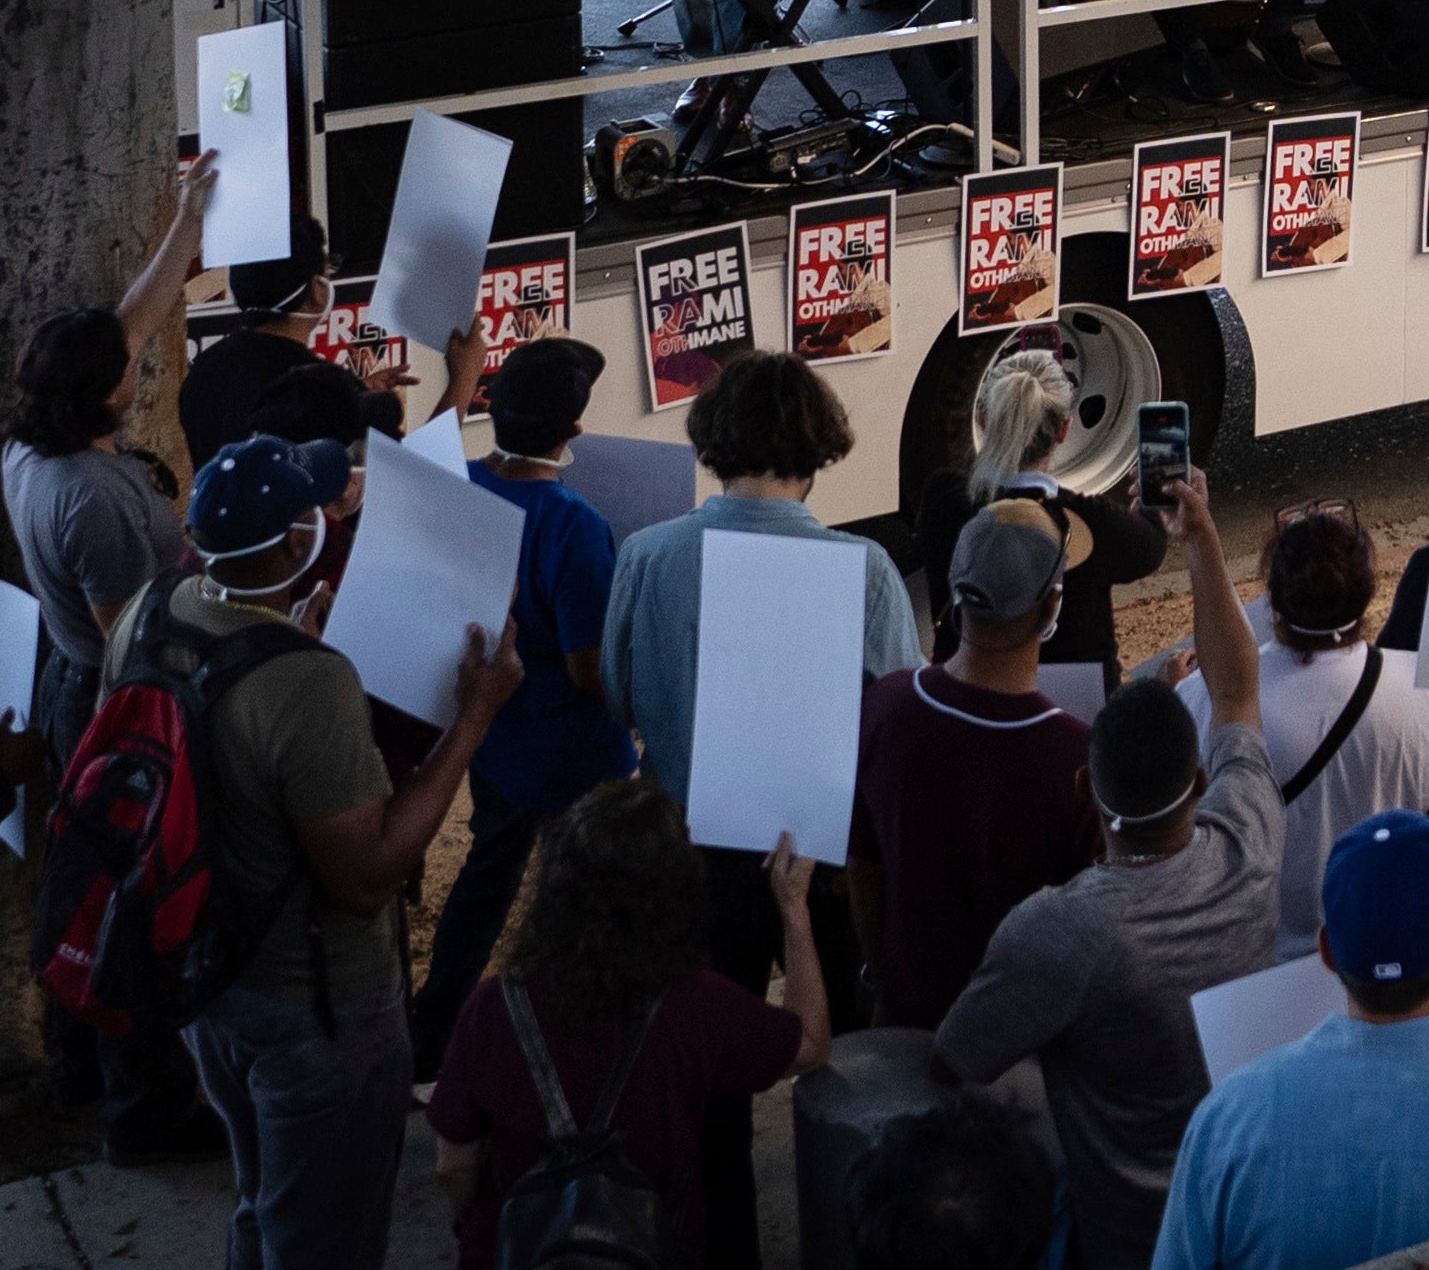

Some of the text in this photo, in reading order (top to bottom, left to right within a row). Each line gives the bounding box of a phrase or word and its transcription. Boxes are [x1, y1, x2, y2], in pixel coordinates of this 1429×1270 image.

[1141, 159, 1221, 202] FREE
[1275, 139, 1350, 179] FREE
[972, 191, 1054, 235] FREE
[1273, 176, 1348, 213] RAMI
[1140, 197, 1219, 236] RAMI
[800, 219, 887, 266] FREE
[970, 229, 1052, 270] RAMI
[475, 261, 565, 310] FREE
[648, 246, 741, 301] FREE
[798, 258, 886, 301] RAMI
[307, 304, 393, 349] FRE
[653, 286, 745, 337] RAMI
[658, 320, 747, 357] OTHMANE
[315, 342, 403, 379] AMI
